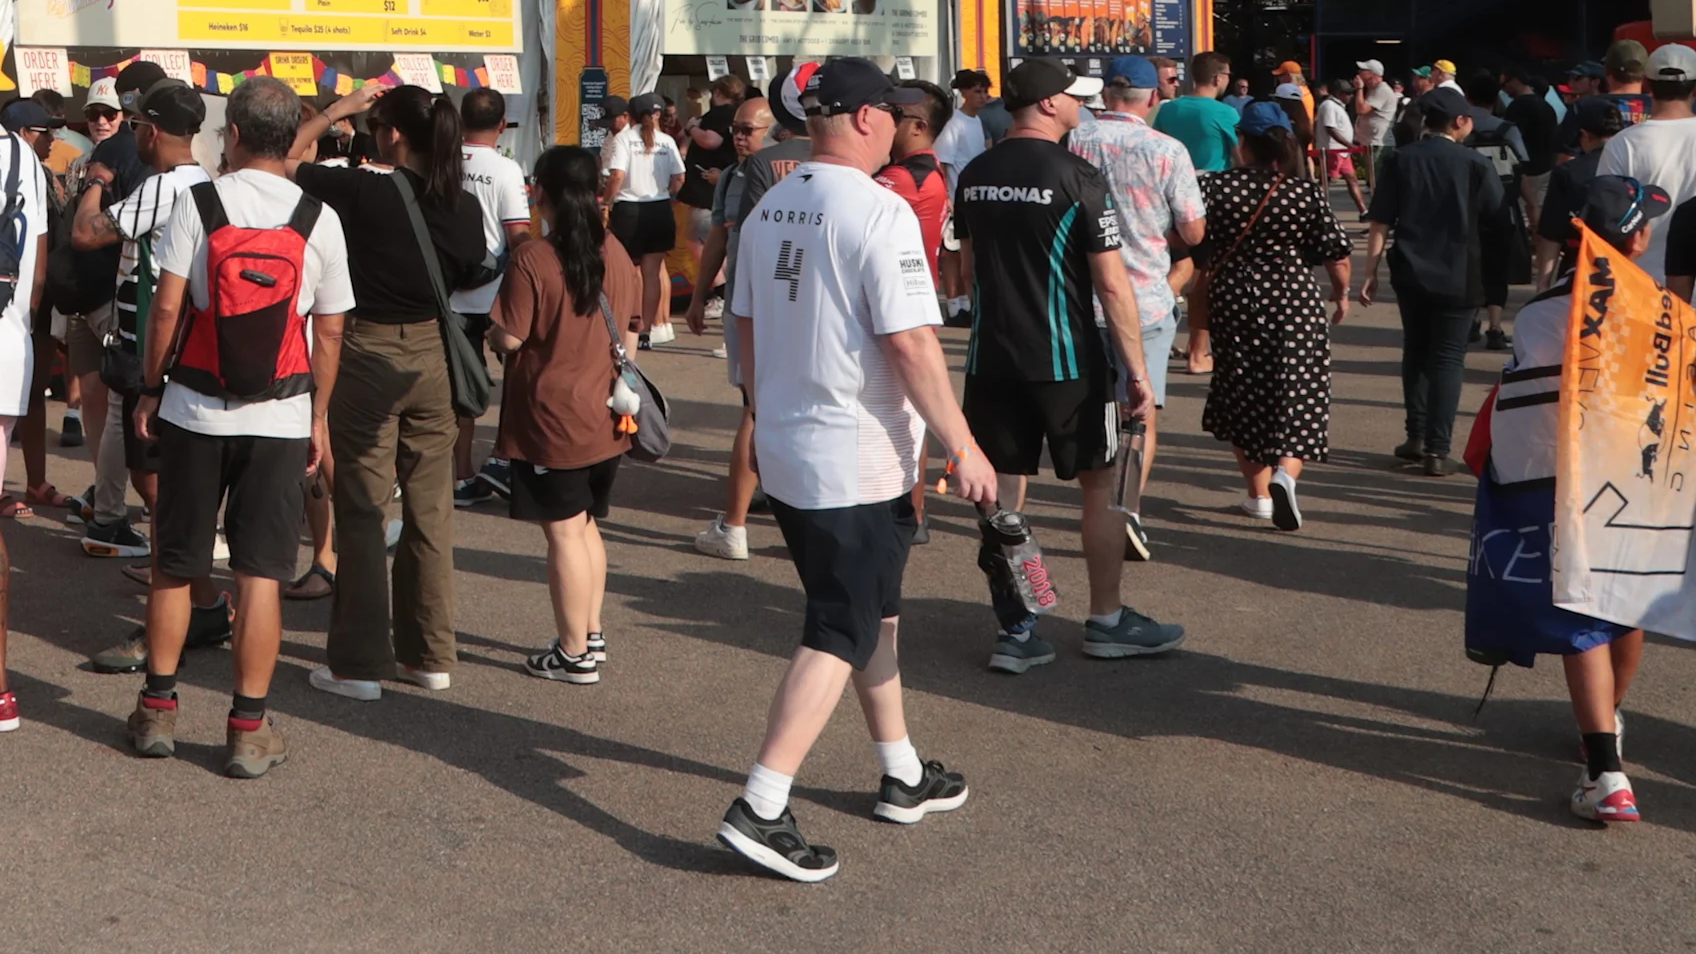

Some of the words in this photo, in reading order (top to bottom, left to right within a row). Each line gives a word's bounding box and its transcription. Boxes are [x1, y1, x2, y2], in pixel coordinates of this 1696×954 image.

[208, 22, 238, 32] Heineken
[291, 25, 312, 35] Tequila
[24, 52, 59, 70] ORDER
[398, 57, 433, 71] COLLECT
[490, 57, 515, 72] ORDER
[30, 72, 59, 91] HERE
[410, 73, 431, 87] HERE
[496, 73, 515, 88] HERE
[964, 186, 1053, 205] PETRONAS
[761, 210, 823, 225] NORRIS
[774, 240, 803, 301] 4
